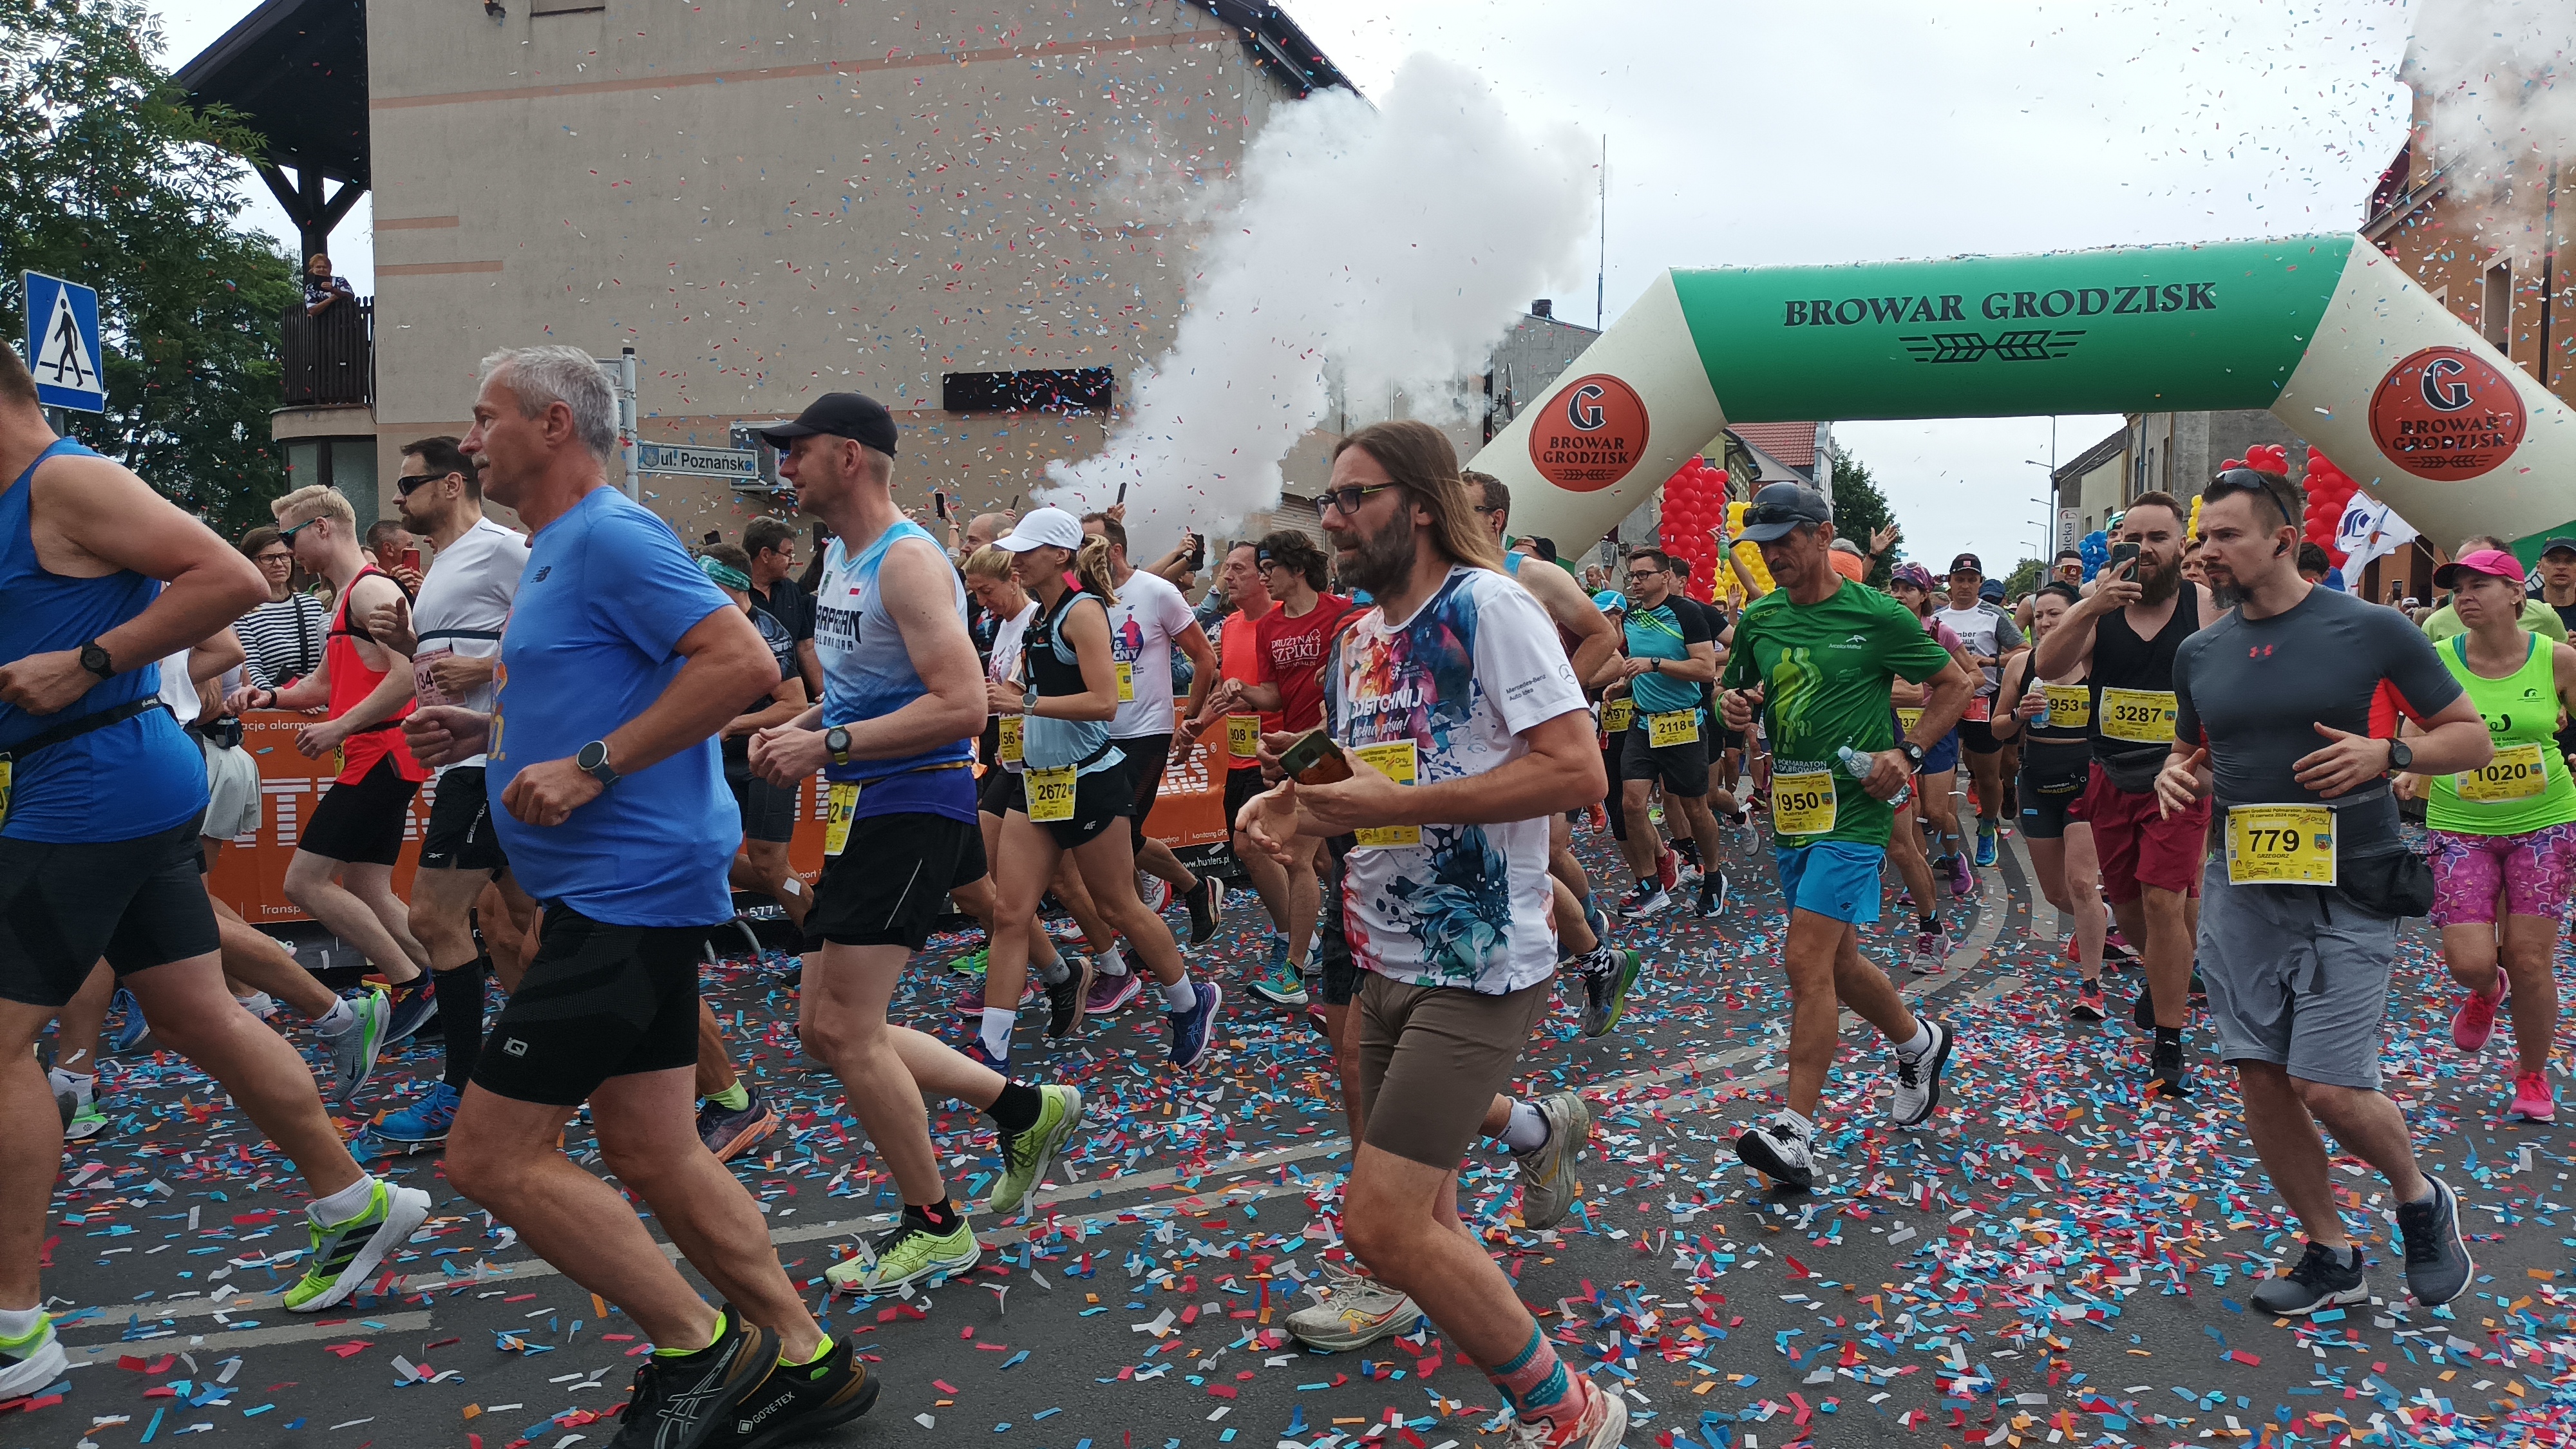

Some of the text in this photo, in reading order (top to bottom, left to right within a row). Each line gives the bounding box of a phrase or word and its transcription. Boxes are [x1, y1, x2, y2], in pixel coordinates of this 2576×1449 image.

[1784, 282, 2216, 326] BROWAR GRODZISK
[2421, 357, 2474, 412] G
[1567, 384, 1607, 431] G
[2400, 416, 2499, 435] BROWAR
[1549, 436, 1624, 450] BROWAR
[2392, 432, 2506, 451] GRODZISK
[661, 452, 752, 471] ul. Poznańska
[1543, 451, 1629, 464] GRODZISK
[2062, 522, 2072, 551] pteka
[1112, 649, 1139, 661] CNY
[1273, 643, 1321, 663] SZPIKU
[1506, 674, 1547, 694] Mercedes-Benz
[1509, 693, 1522, 701] Auto
[2115, 705, 2162, 723] 3287
[242, 719, 266, 732] acje
[1230, 728, 1246, 741] 908
[1658, 720, 1687, 734] 2118
[1777, 758, 1828, 768] PÓŁMARATON
[2474, 763, 2527, 782] 1020
[1037, 783, 1067, 800] 2672
[1776, 791, 1819, 811] 1950
[2248, 829, 2300, 853] 779
[1182, 854, 1230, 868] ww.hunters.pl
[260, 904, 301, 916] Transp
[749, 905, 773, 917] 577
